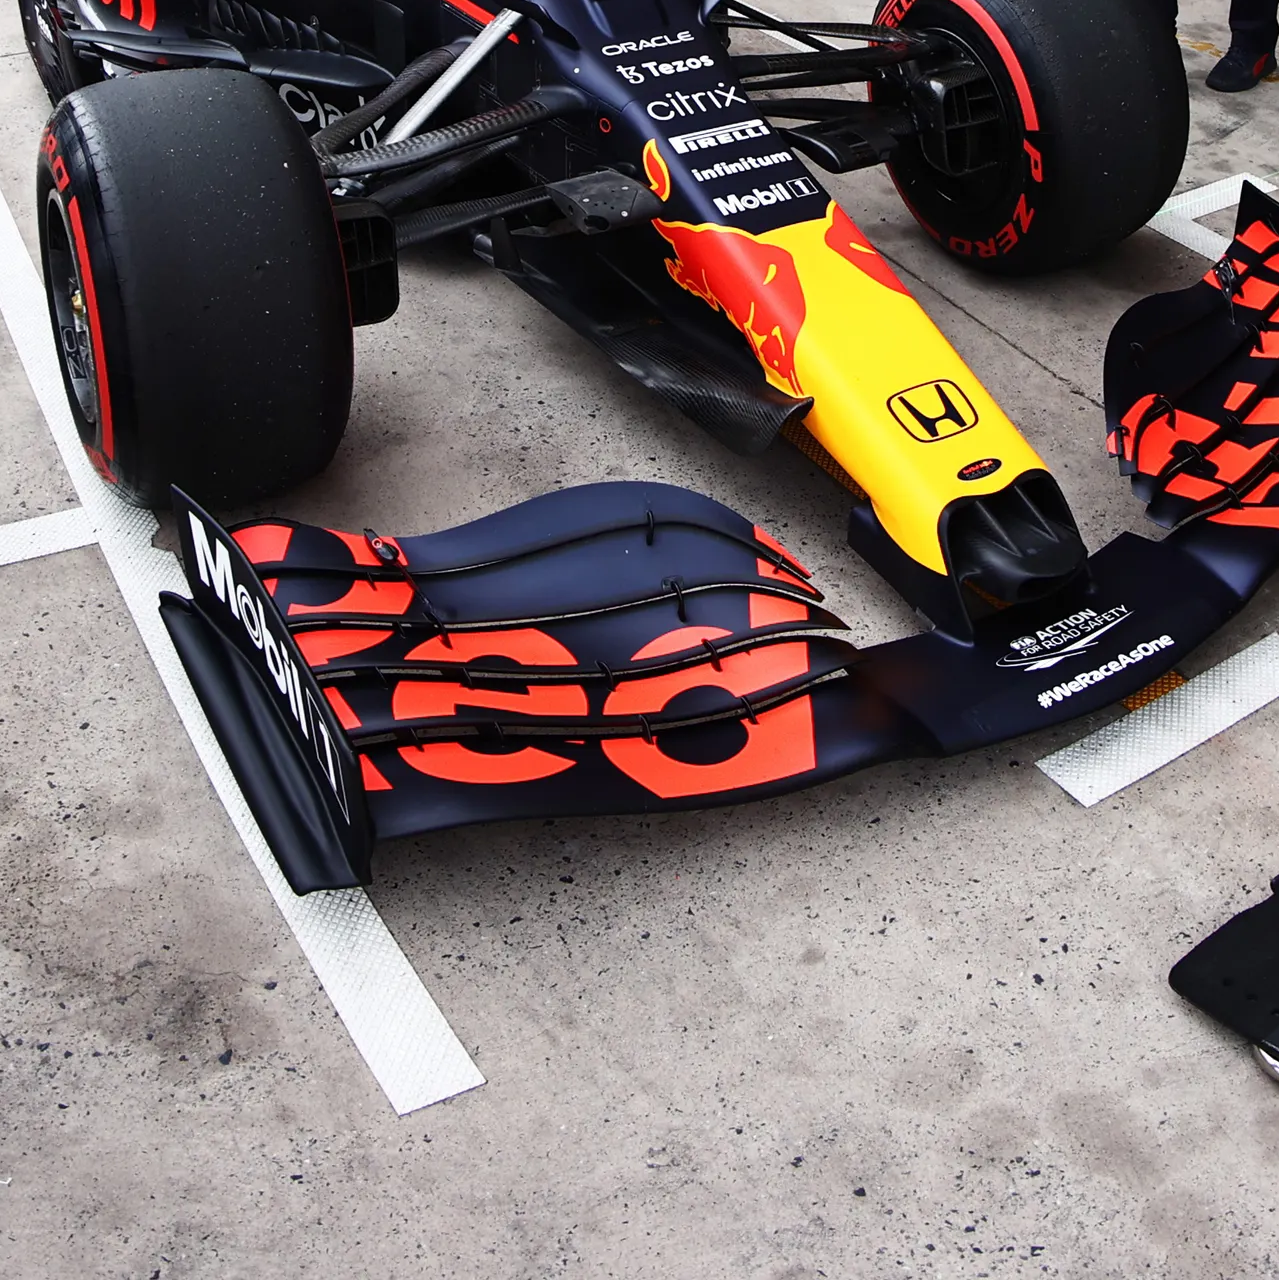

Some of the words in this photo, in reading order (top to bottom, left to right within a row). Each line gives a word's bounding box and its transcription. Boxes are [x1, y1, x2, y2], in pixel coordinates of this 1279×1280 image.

[602, 30, 695, 56] ORACLE
[641, 54, 714, 78] Tezos
[646, 82, 747, 121] citrix
[668, 118, 771, 155] PIRELLI
[691, 149, 793, 183] infinitum
[1023, 139, 1044, 183] P
[712, 182, 790, 217] Mobil
[948, 193, 1036, 260] ZERO
[187, 510, 309, 740] Mobil
[1020, 642, 1043, 658] FOR
[1042, 628, 1080, 650] ROAD
[1077, 604, 1131, 631] SAFETY
[1036, 608, 1098, 640] ACTION
[1011, 637, 1036, 650] FIA
[1037, 632, 1175, 710] #WeRaceAsOne
